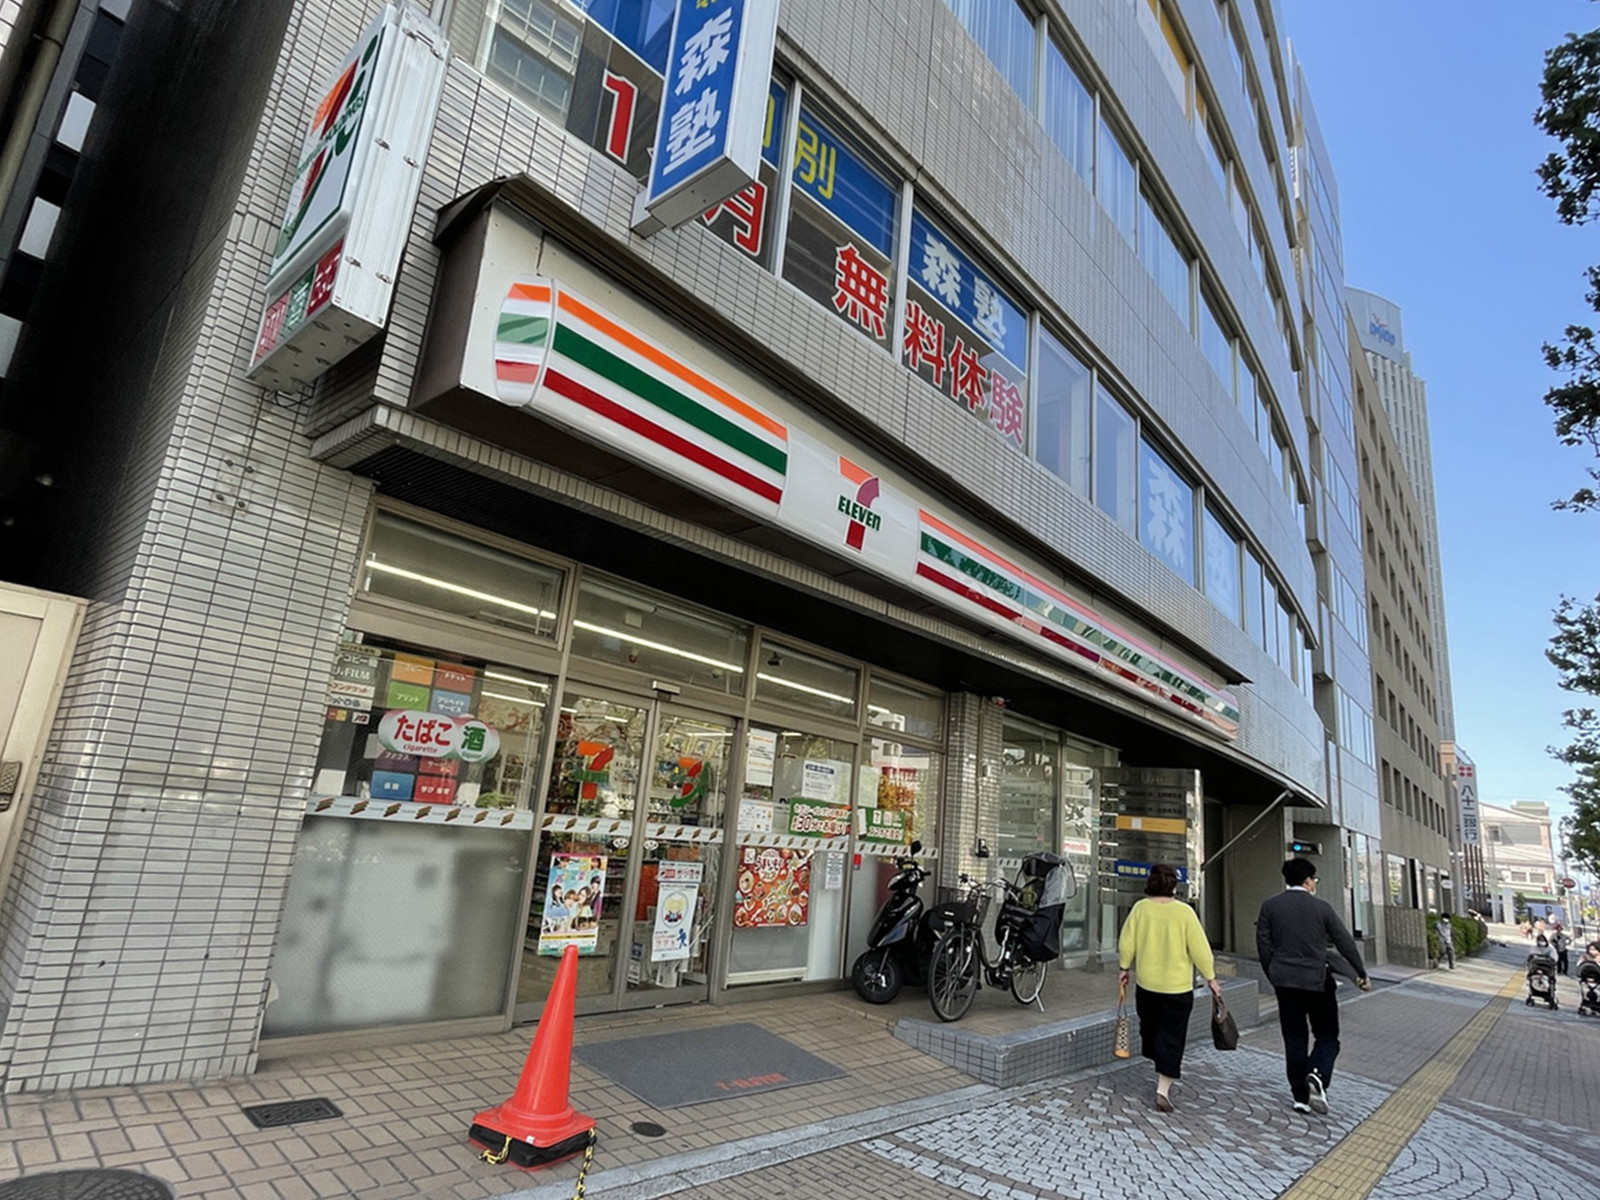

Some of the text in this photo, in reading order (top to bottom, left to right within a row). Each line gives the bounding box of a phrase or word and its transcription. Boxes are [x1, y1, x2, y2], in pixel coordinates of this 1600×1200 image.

[664, 6, 732, 176] 森塾
[922, 232, 1007, 351] 森塾
[394, 715, 487, 752] たばこ 酒
[1461, 784, 1478, 840] 八十二銀行
